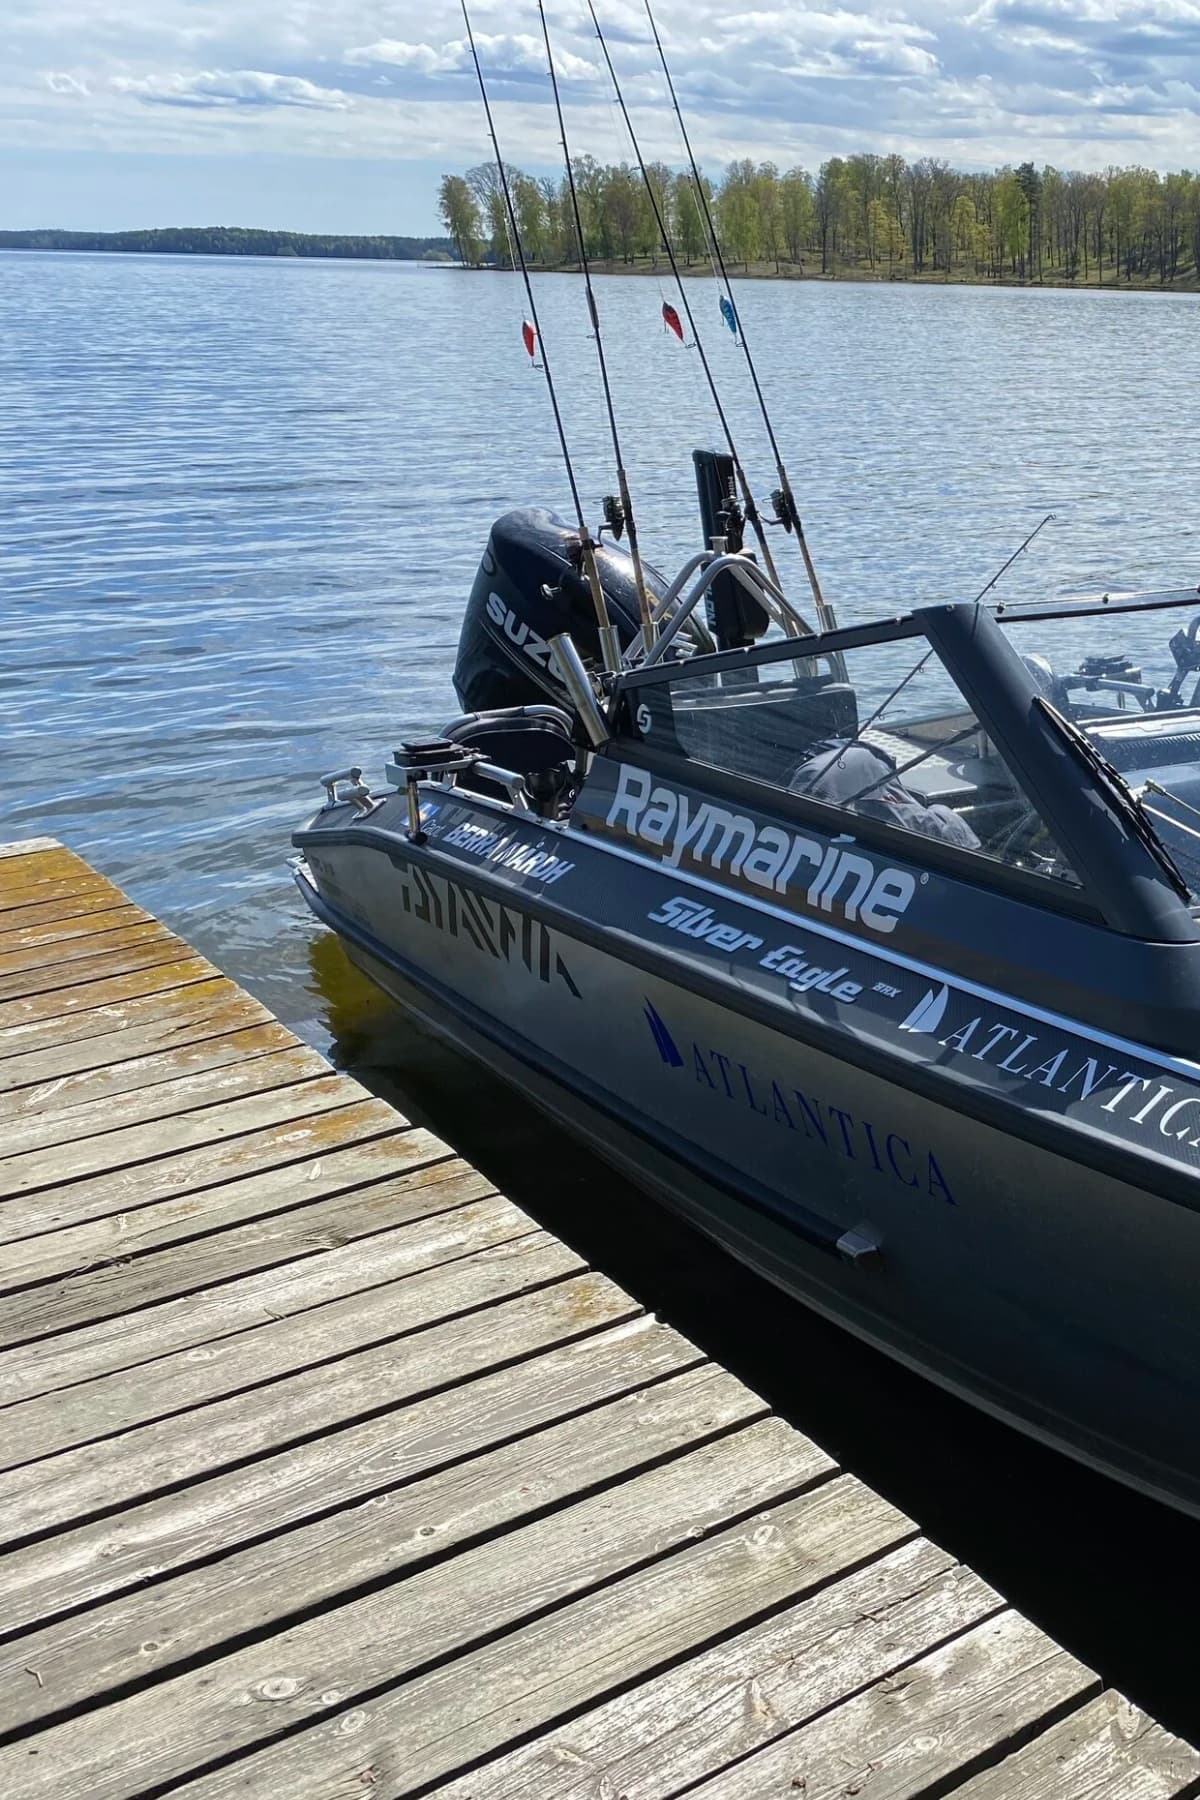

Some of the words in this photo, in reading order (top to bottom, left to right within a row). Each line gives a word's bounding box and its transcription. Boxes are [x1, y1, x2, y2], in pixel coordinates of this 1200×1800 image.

[486, 591, 565, 682] SUZ
[606, 763, 916, 933] Raymarine
[647, 896, 764, 953] Silver
[759, 945, 864, 1003] Eagle
[692, 1041, 958, 1207] ATLANTICA
